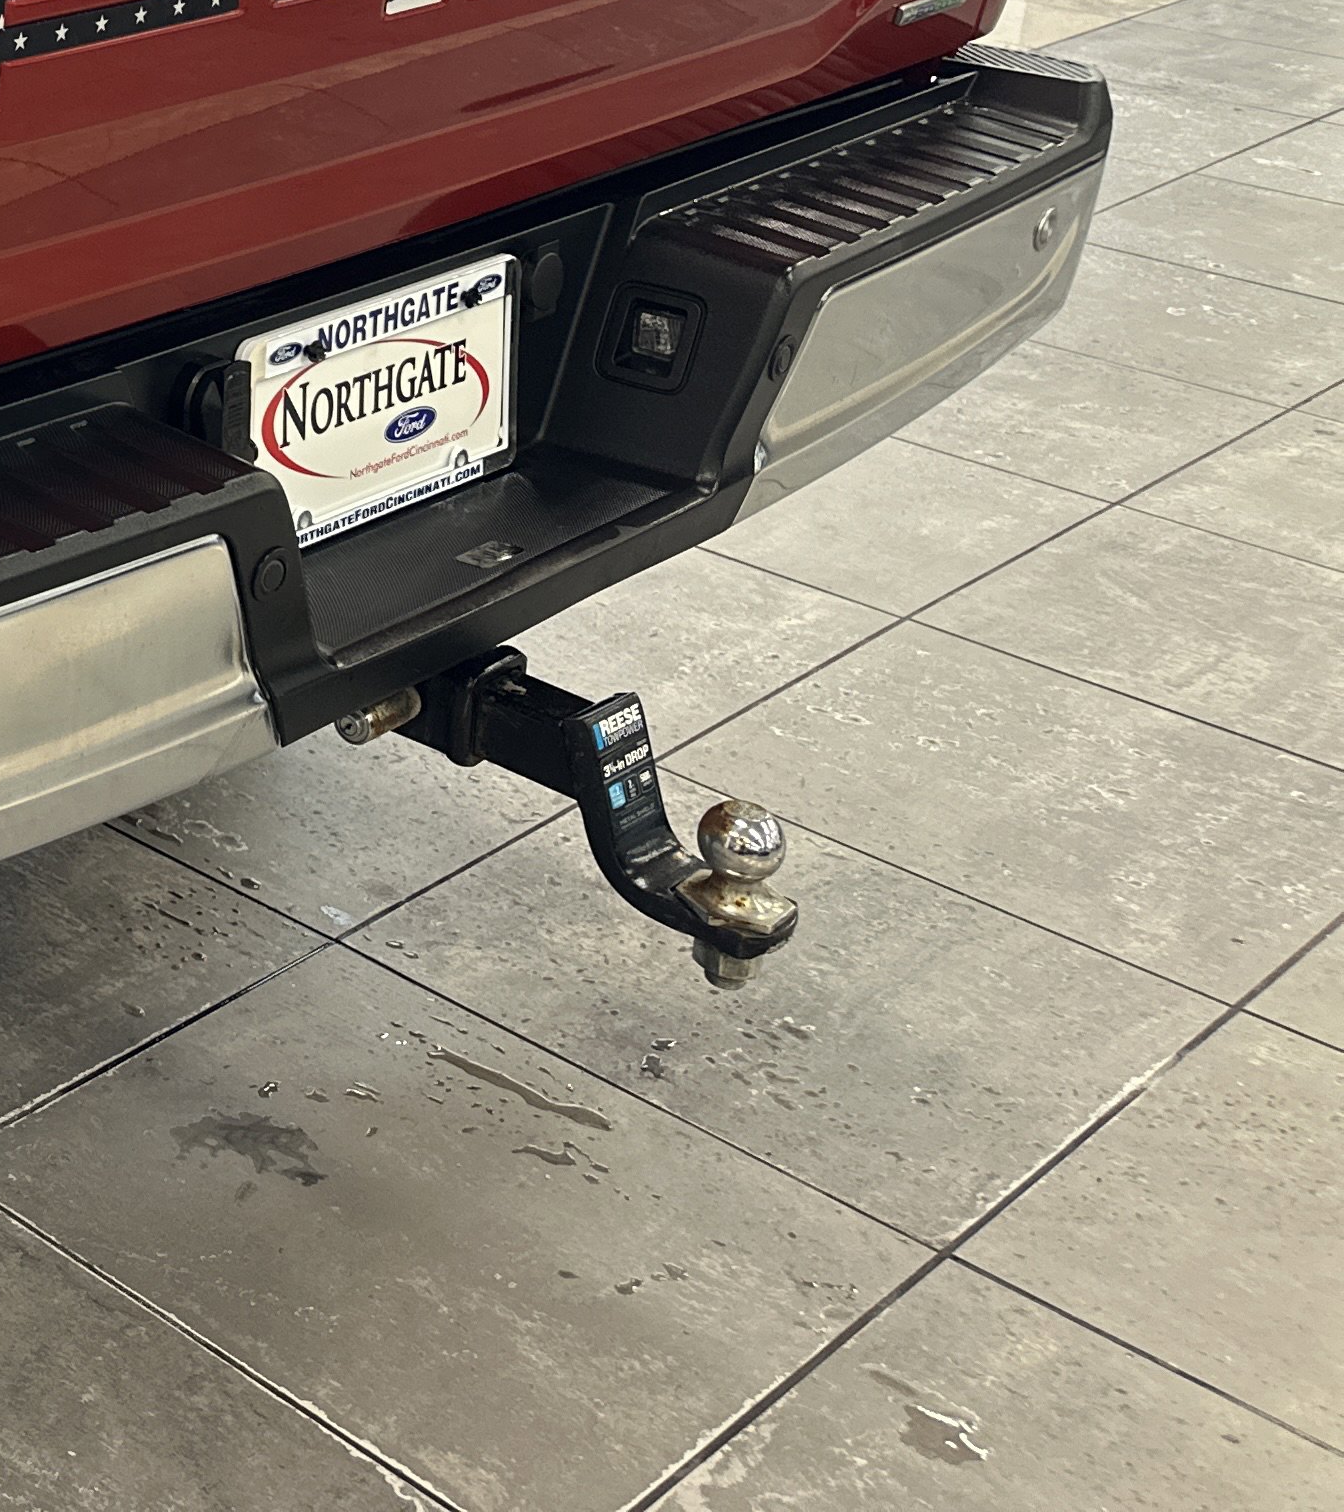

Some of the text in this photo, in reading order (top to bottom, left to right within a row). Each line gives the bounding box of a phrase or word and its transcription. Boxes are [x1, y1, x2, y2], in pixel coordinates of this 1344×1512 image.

[317, 281, 460, 353] NORTHGATE
[279, 338, 468, 449] NORTHGATE
[349, 428, 469, 481] NorthgateFordCincinnati.com
[298, 463, 481, 544] RTHGATEFORDCINCINNATI.COM
[599, 703, 642, 737] REESE
[603, 719, 644, 748] TOWPOWER
[624, 744, 649, 767] DROP
